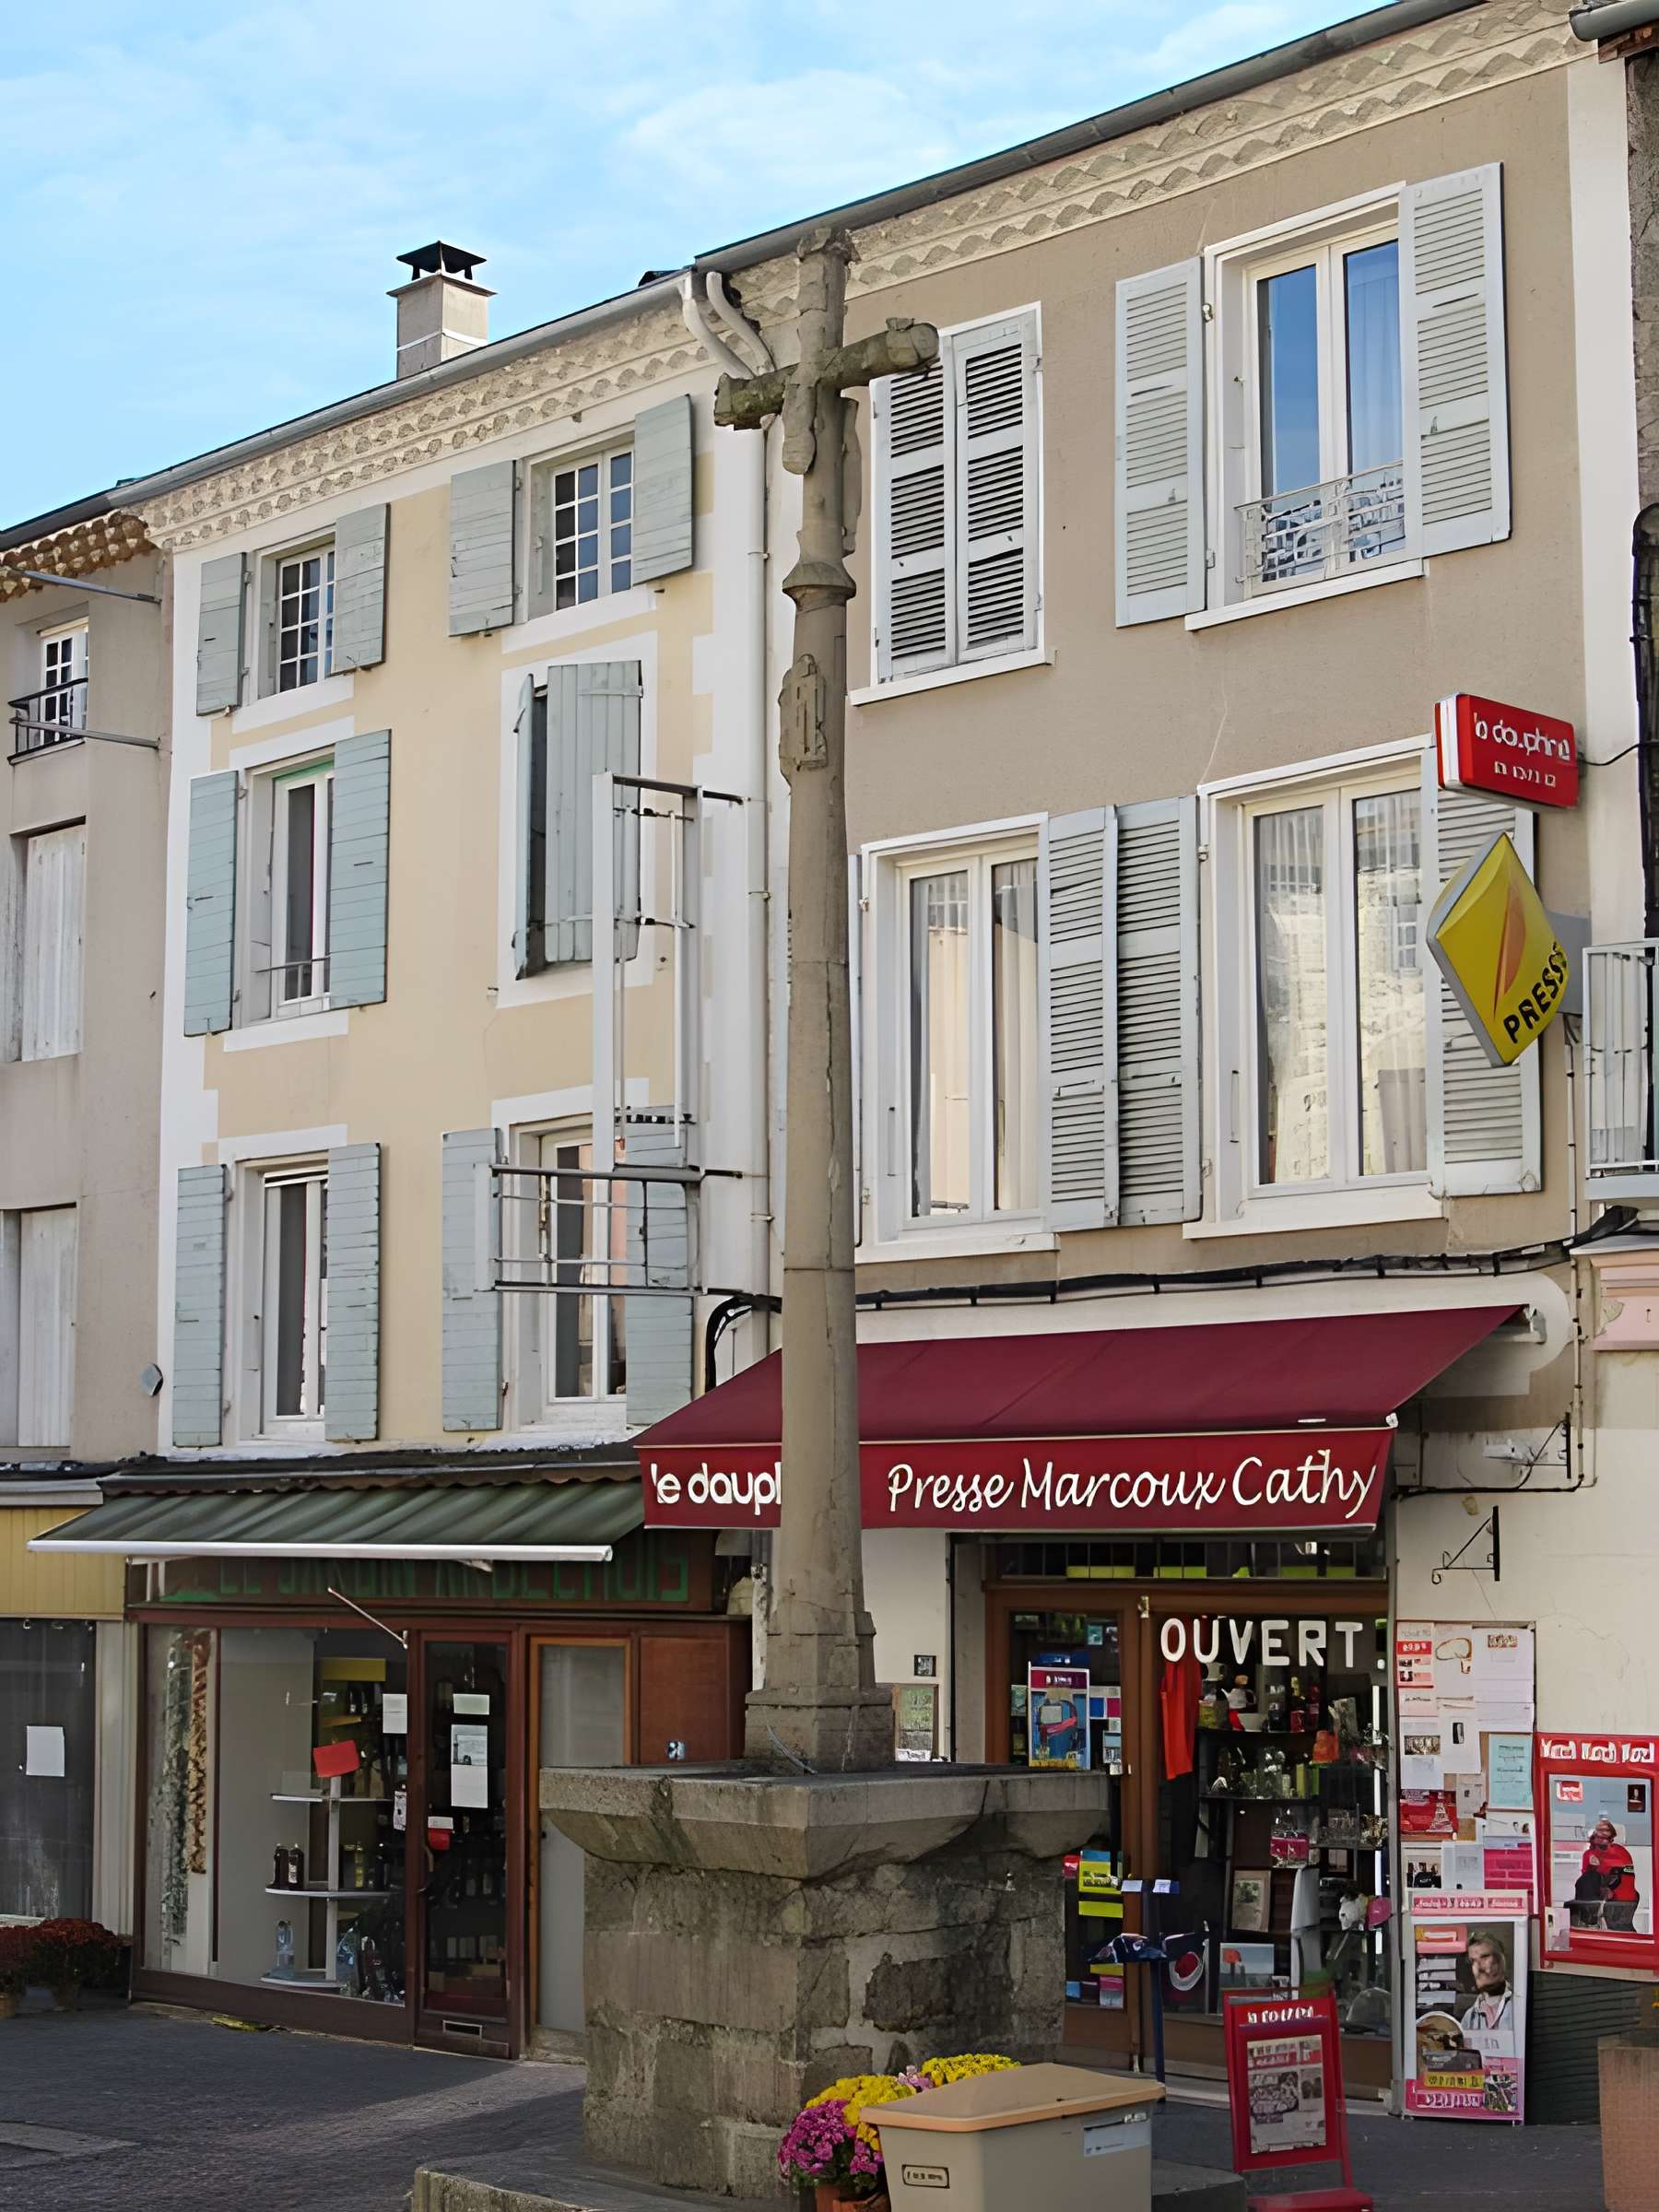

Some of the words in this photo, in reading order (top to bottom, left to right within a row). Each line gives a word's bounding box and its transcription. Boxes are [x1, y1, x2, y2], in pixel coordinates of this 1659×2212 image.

[651, 1463, 682, 1504] le
[888, 1463, 1014, 1512] Presse
[1019, 1457, 1227, 1511] Marcoux
[1231, 1449, 1377, 1519] Cathy
[1160, 1618, 1364, 1668] OUVERT
